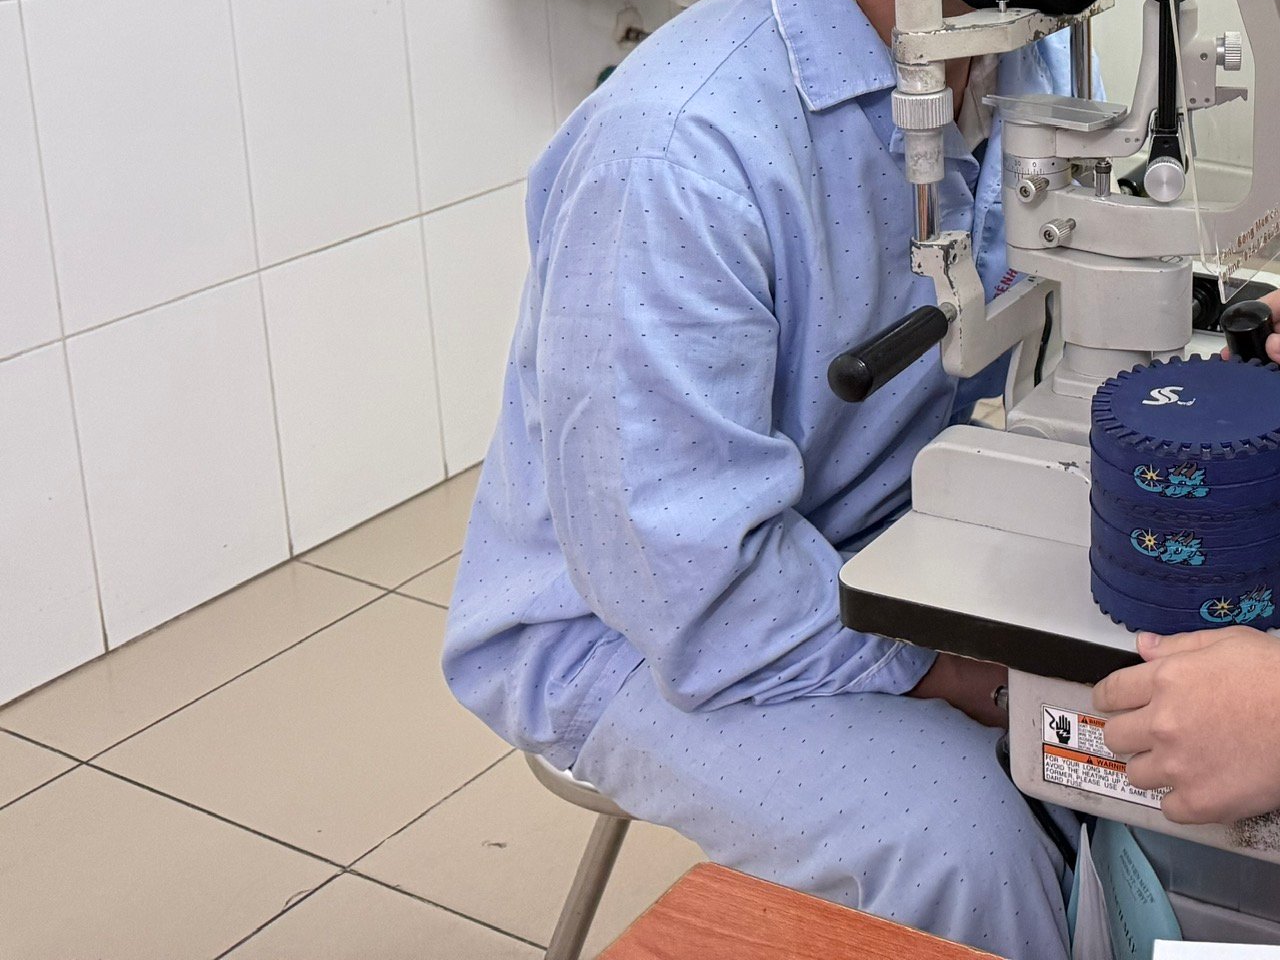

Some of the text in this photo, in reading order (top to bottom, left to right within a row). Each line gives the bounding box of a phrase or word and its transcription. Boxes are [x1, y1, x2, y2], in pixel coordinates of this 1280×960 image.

[1046, 754, 1059, 762] FOR
[1062, 758, 1080, 768] YOUR
[1083, 764, 1101, 774] LONG
[1046, 762, 1065, 771] AVOID
[1068, 766, 1079, 775] THE
[1082, 770, 1109, 782] HEATING
[1096, 759, 1127, 772] WARNIN
[1046, 773, 1083, 788] DARD FUSE
[1076, 775, 1101, 786] PLEASE
[1104, 781, 1118, 791] USE
[1129, 788, 1148, 798] SAME
